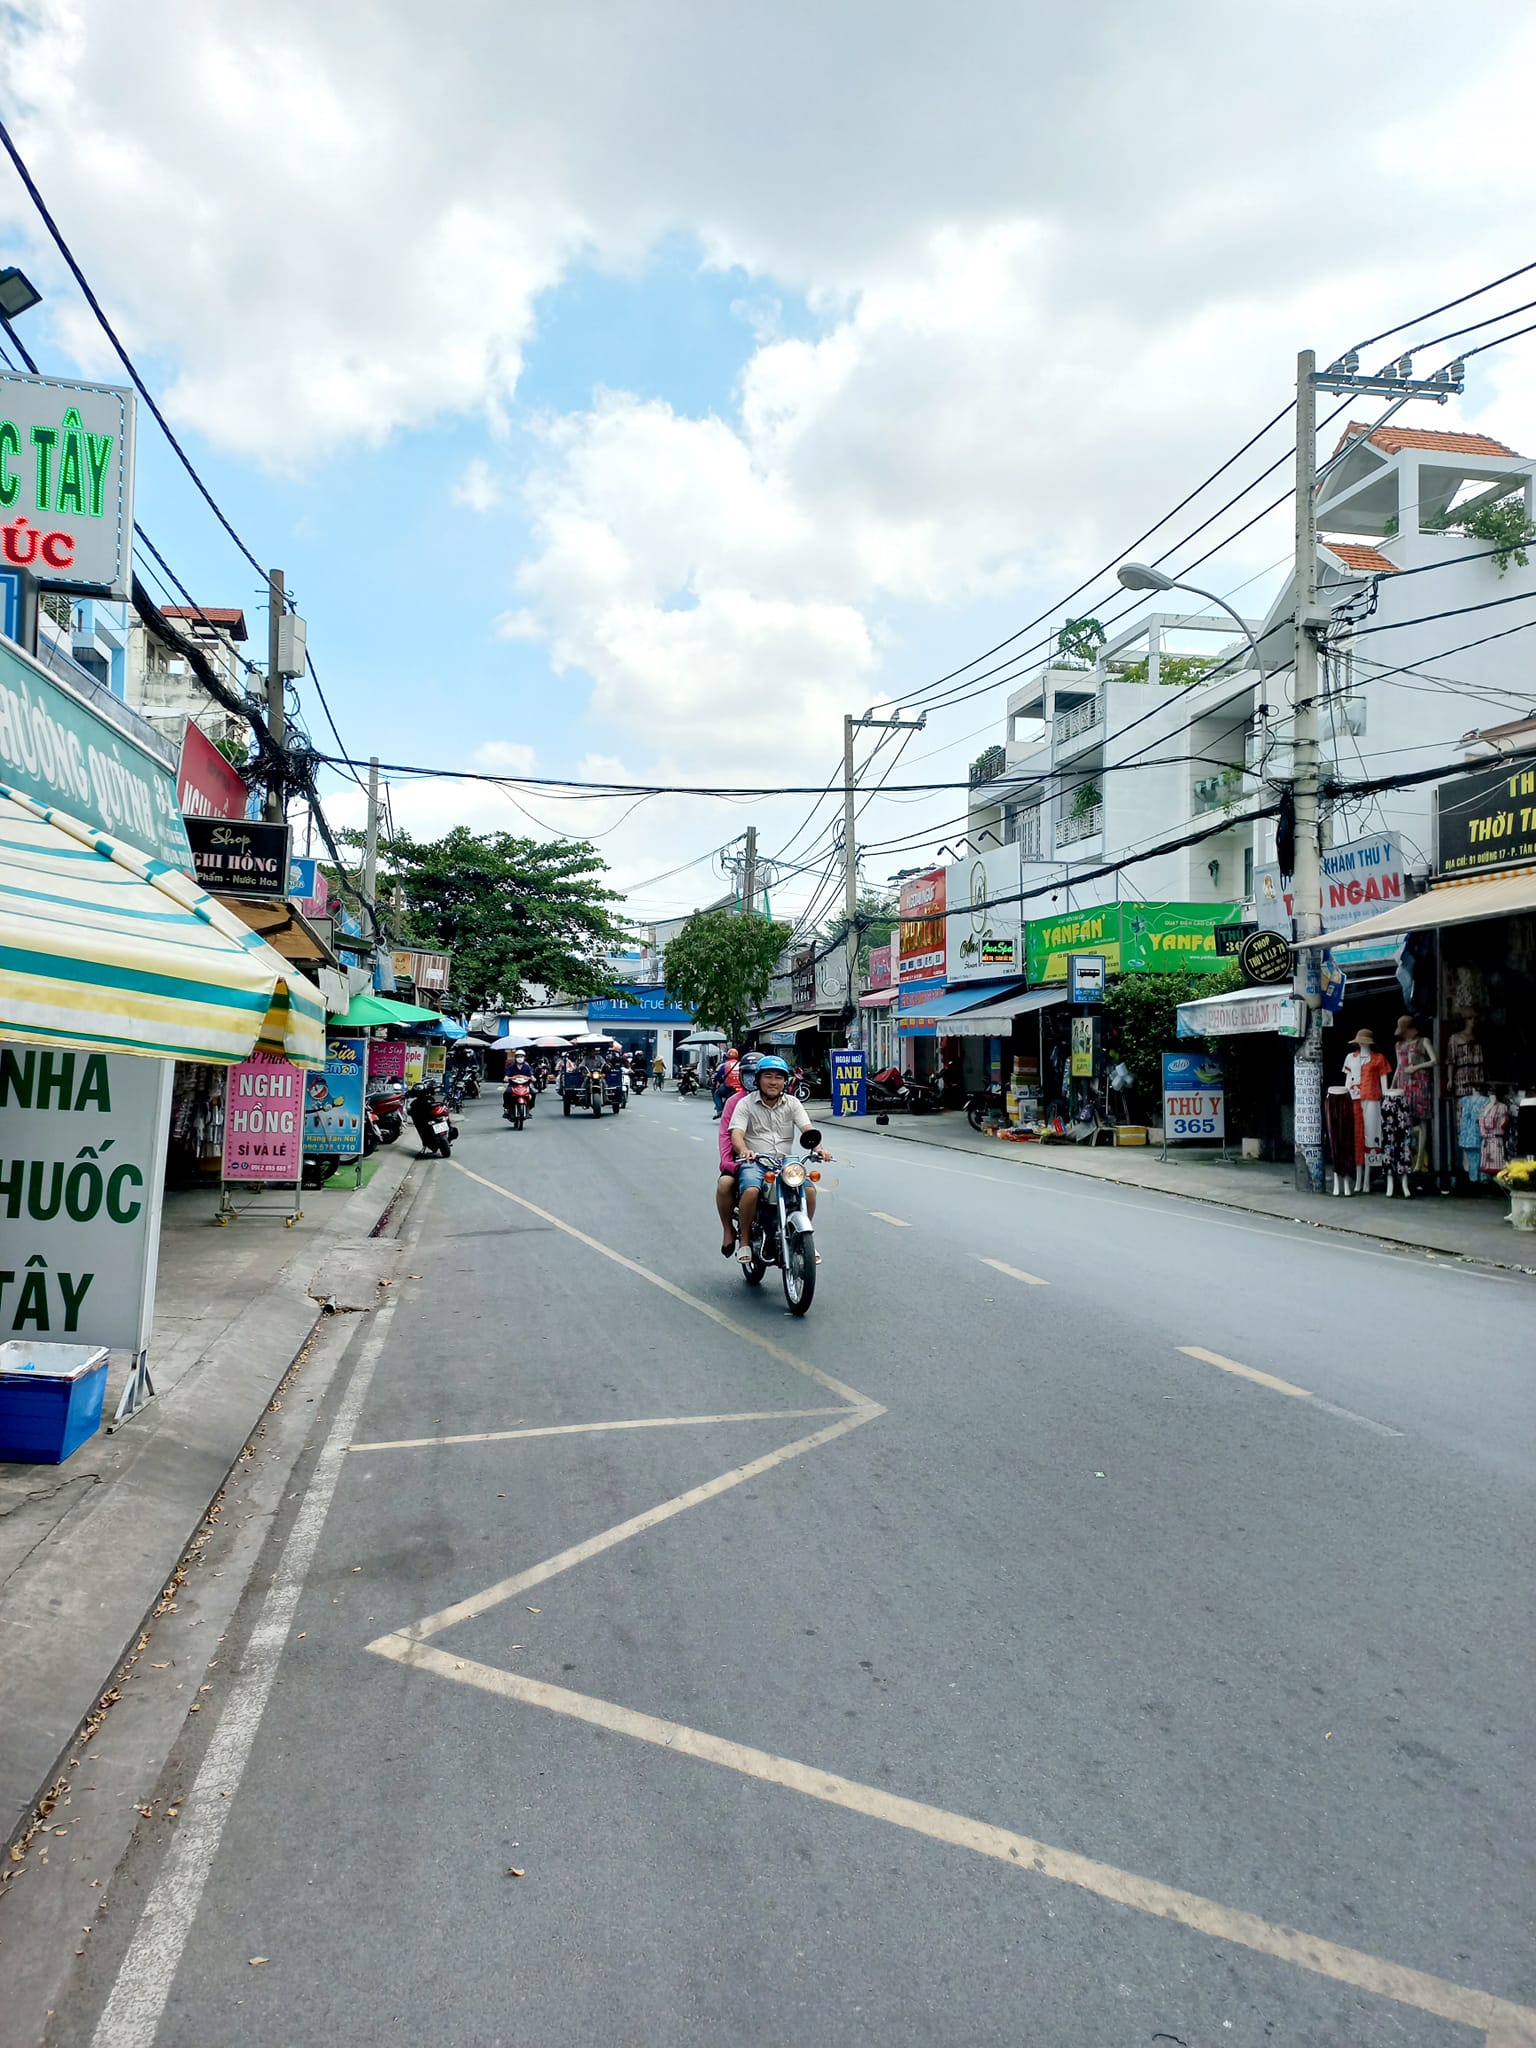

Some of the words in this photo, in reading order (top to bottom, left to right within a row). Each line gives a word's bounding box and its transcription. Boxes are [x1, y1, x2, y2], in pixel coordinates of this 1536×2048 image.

[30, 407, 113, 518] TÂY
[1469, 811, 1514, 843] THỜI
[210, 826, 252, 854] Shop
[228, 849, 278, 873] HỒNG
[1358, 842, 1380, 867] THÚ
[1383, 843, 1392, 862] Y
[232, 874, 256, 885] Nước
[259, 876, 278, 886] Hoa
[1042, 918, 1103, 948] YANFAN
[1208, 1004, 1238, 1028] PHÒNG
[1241, 1000, 1270, 1026] KHÁM
[326, 1042, 357, 1060] Sữa
[836, 1066, 863, 1079] ANH
[239, 1074, 292, 1097] NGHI
[840, 1081, 859, 1096] MỸ
[1167, 1092, 1203, 1116] THÚ
[1209, 1097, 1222, 1116] Y
[233, 1102, 294, 1133] HỒNG
[1174, 1118, 1216, 1134] 365
[238, 1142, 250, 1156] SỈ
[253, 1142, 269, 1156] VÀ
